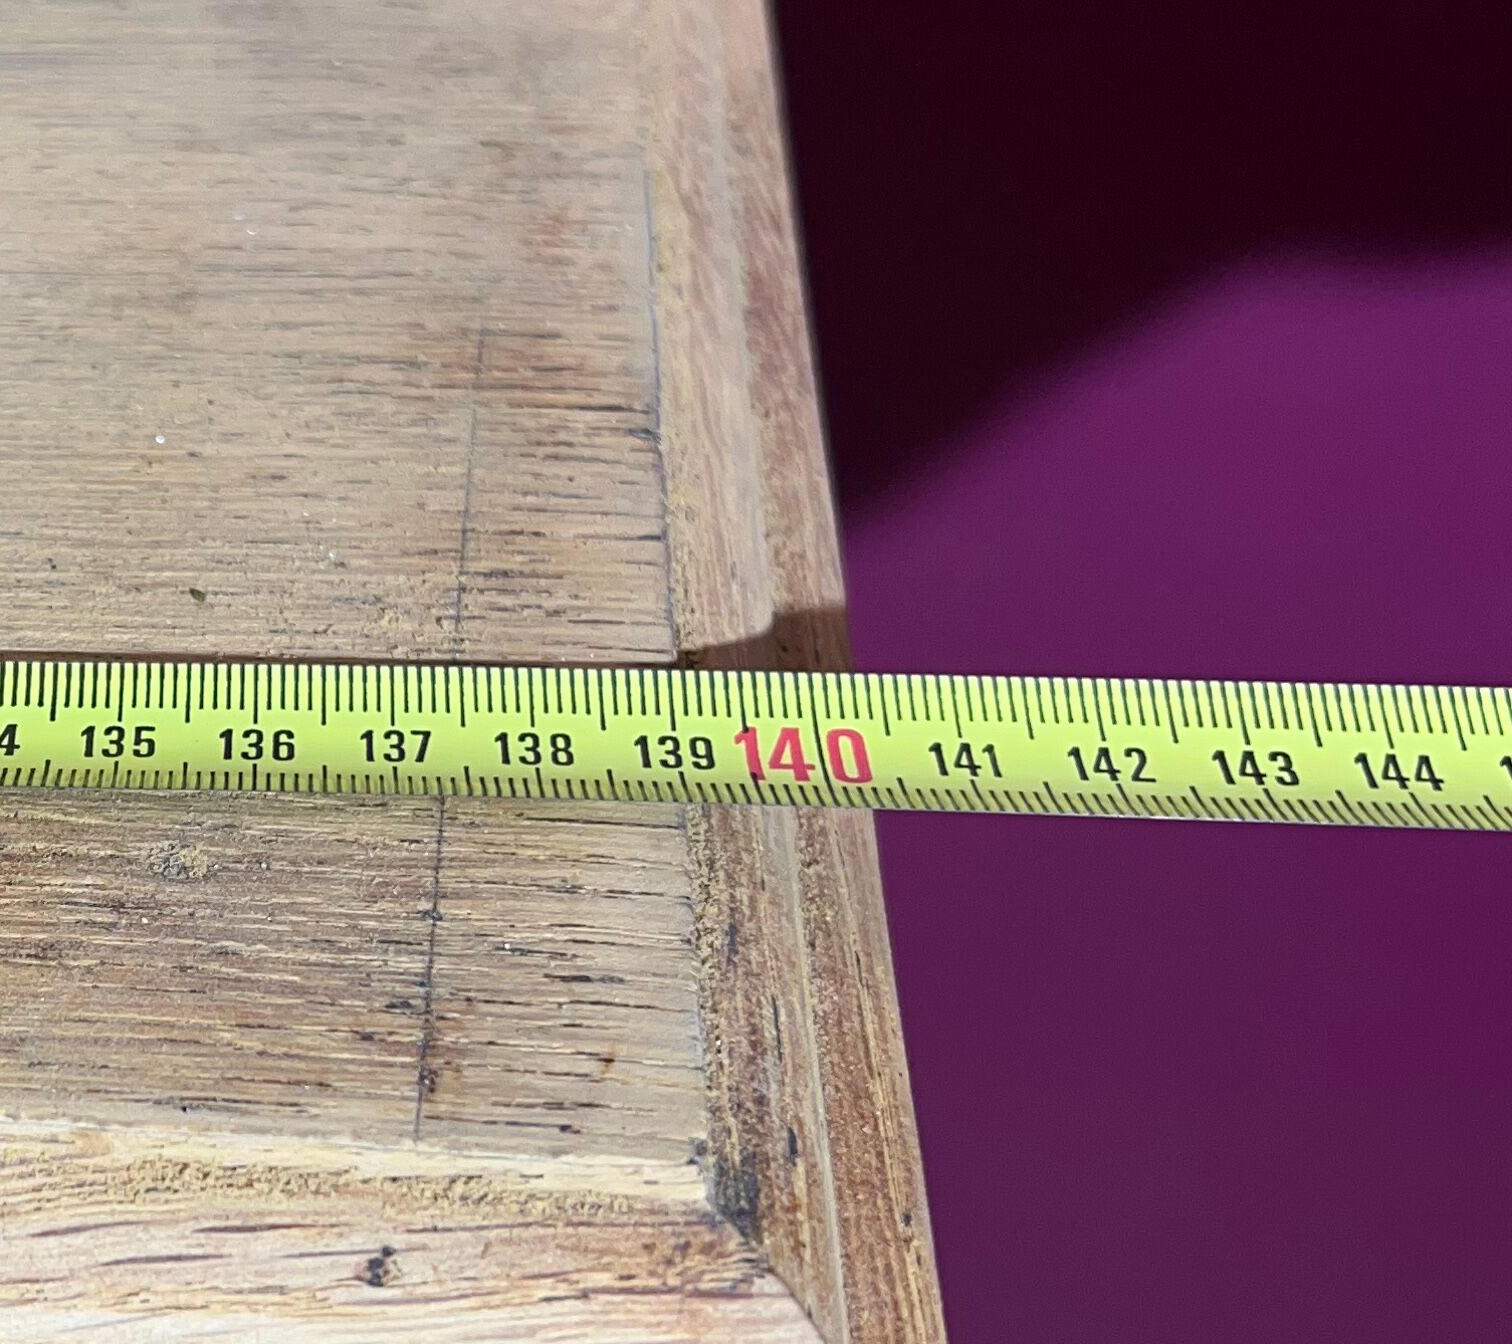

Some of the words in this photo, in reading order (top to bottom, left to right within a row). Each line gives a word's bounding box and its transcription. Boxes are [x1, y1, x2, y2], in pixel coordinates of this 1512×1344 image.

[79, 725, 157, 758] 135
[218, 728, 296, 762] 136
[359, 729, 432, 763] 137
[494, 731, 575, 767] 138
[633, 734, 716, 771] 139
[733, 726, 874, 784] 140
[927, 741, 1003, 779] 141
[1066, 746, 1158, 784] 142
[1211, 749, 1300, 787] 143
[1353, 752, 1445, 792] 144
